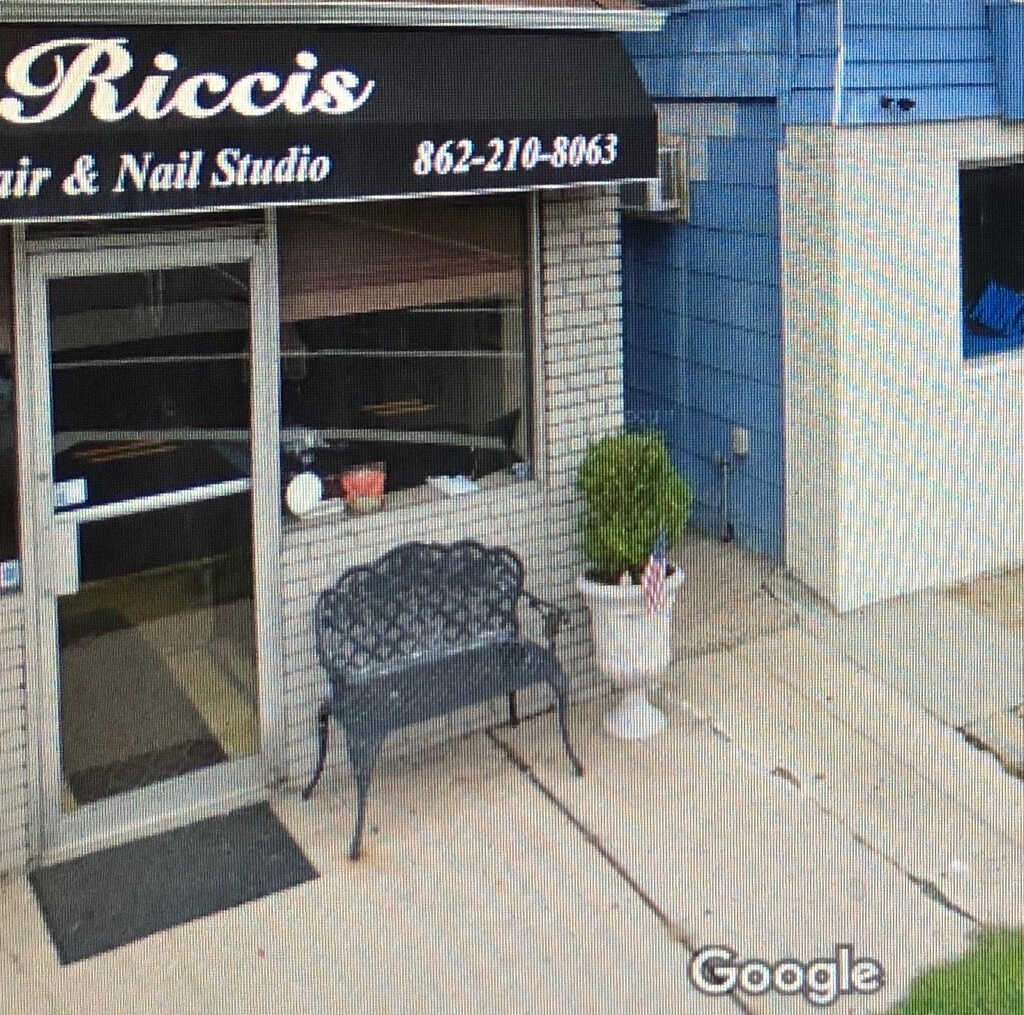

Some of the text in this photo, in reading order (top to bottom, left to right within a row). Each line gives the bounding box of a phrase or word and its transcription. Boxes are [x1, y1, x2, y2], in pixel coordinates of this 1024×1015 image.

[1, 37, 375, 124] Riccis
[61, 154, 99, 196] &
[112, 150, 204, 193] Nail
[210, 146, 332, 188] Studio
[412, 133, 619, 176] 862-210-8063
